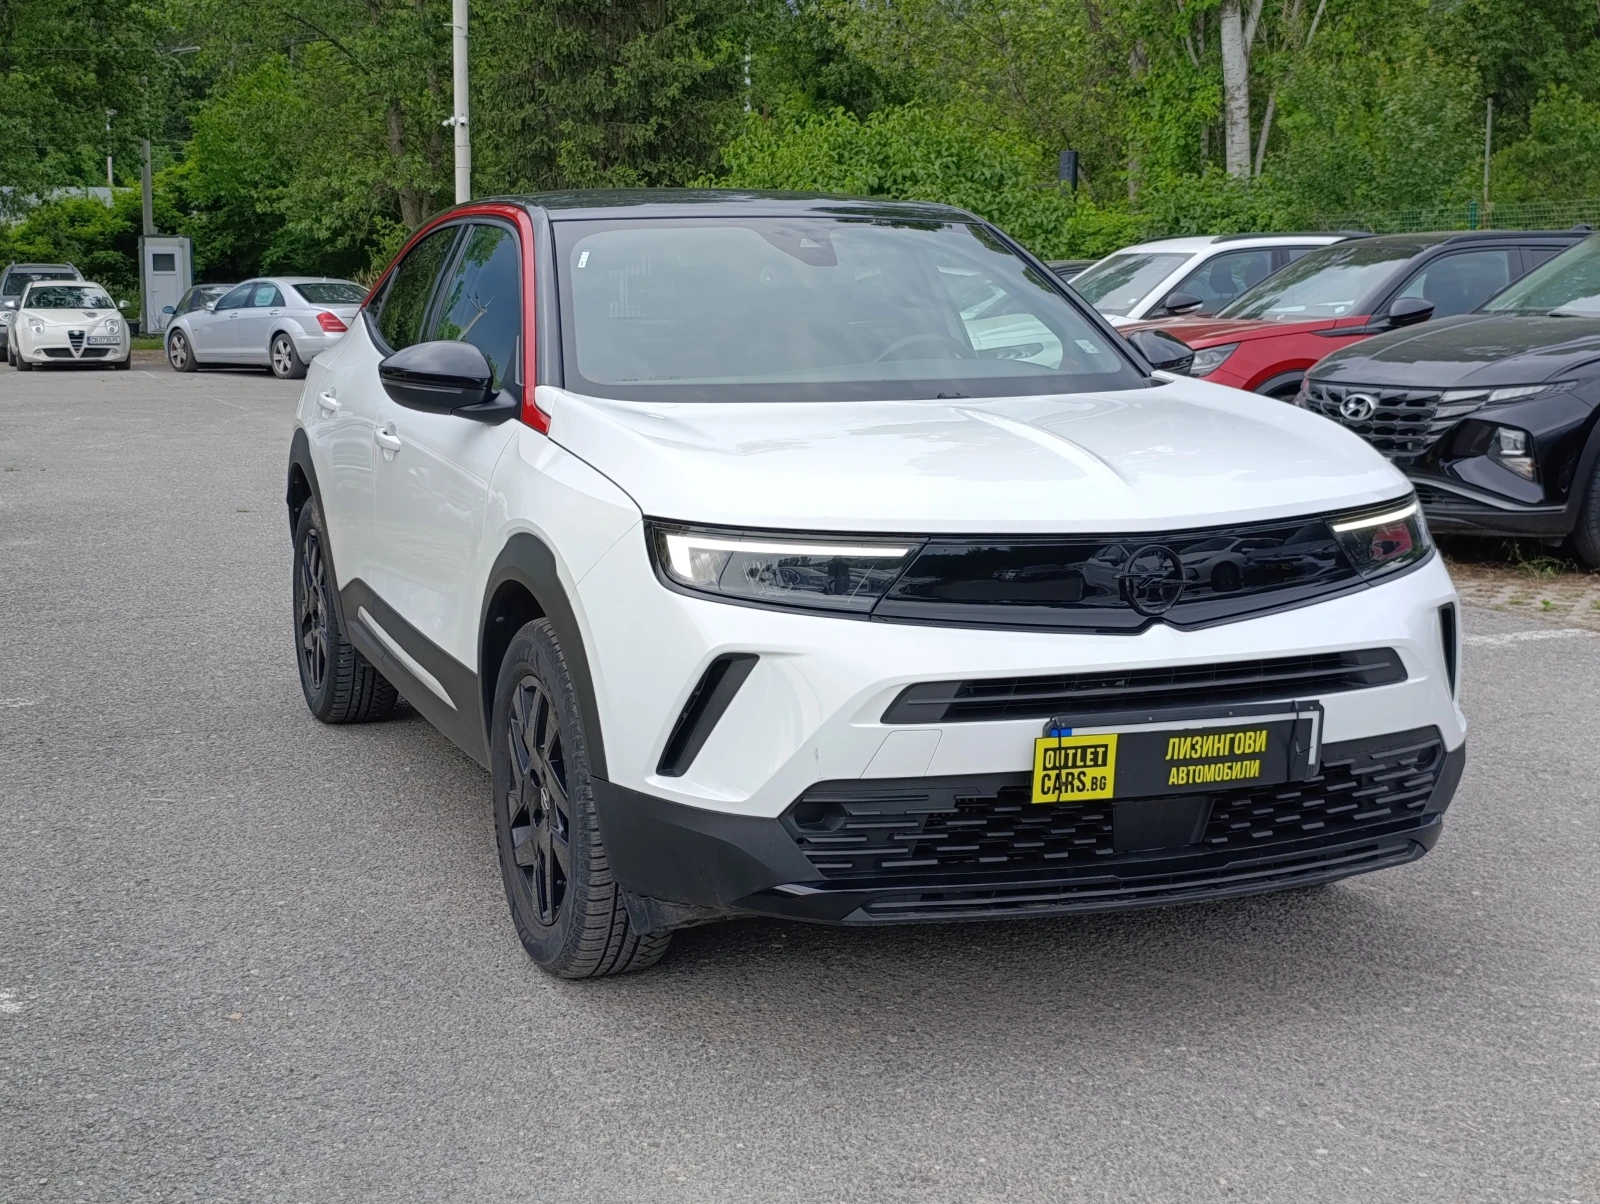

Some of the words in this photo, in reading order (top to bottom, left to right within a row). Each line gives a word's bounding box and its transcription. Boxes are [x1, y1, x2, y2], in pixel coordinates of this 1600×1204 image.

[1045, 747, 1106, 768] OUTLET
[1165, 731, 1267, 760] ЛИЗИНГОВИ
[1041, 771, 1107, 795] CARS.BG
[1168, 760, 1260, 785] АВТОМОБИЛИ
